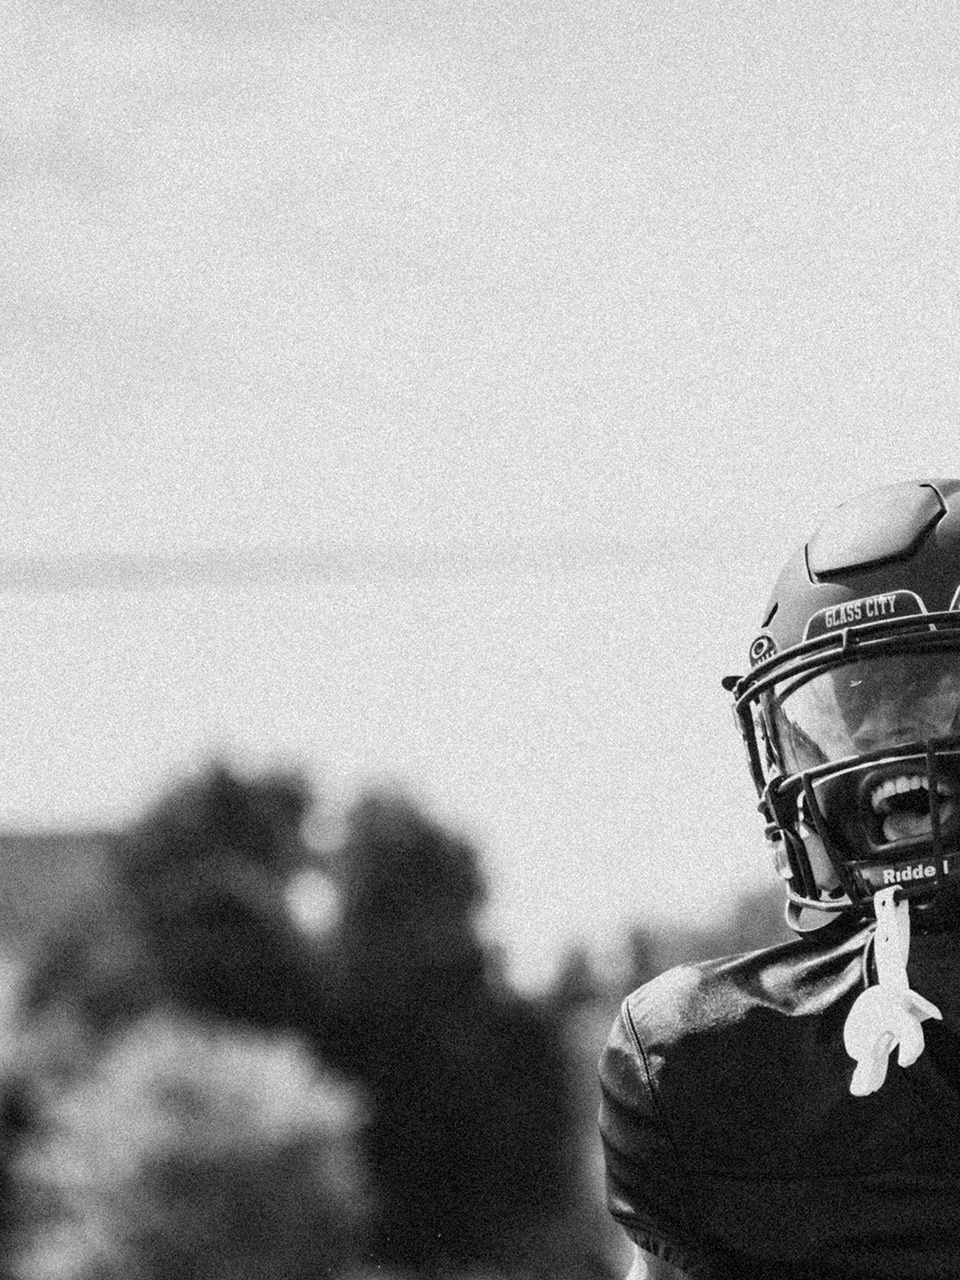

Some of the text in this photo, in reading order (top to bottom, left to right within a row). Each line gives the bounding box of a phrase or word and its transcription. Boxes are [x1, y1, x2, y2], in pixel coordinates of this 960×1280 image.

[825, 595, 896, 628] GLASS CITY
[883, 860, 949, 884] Riddel
